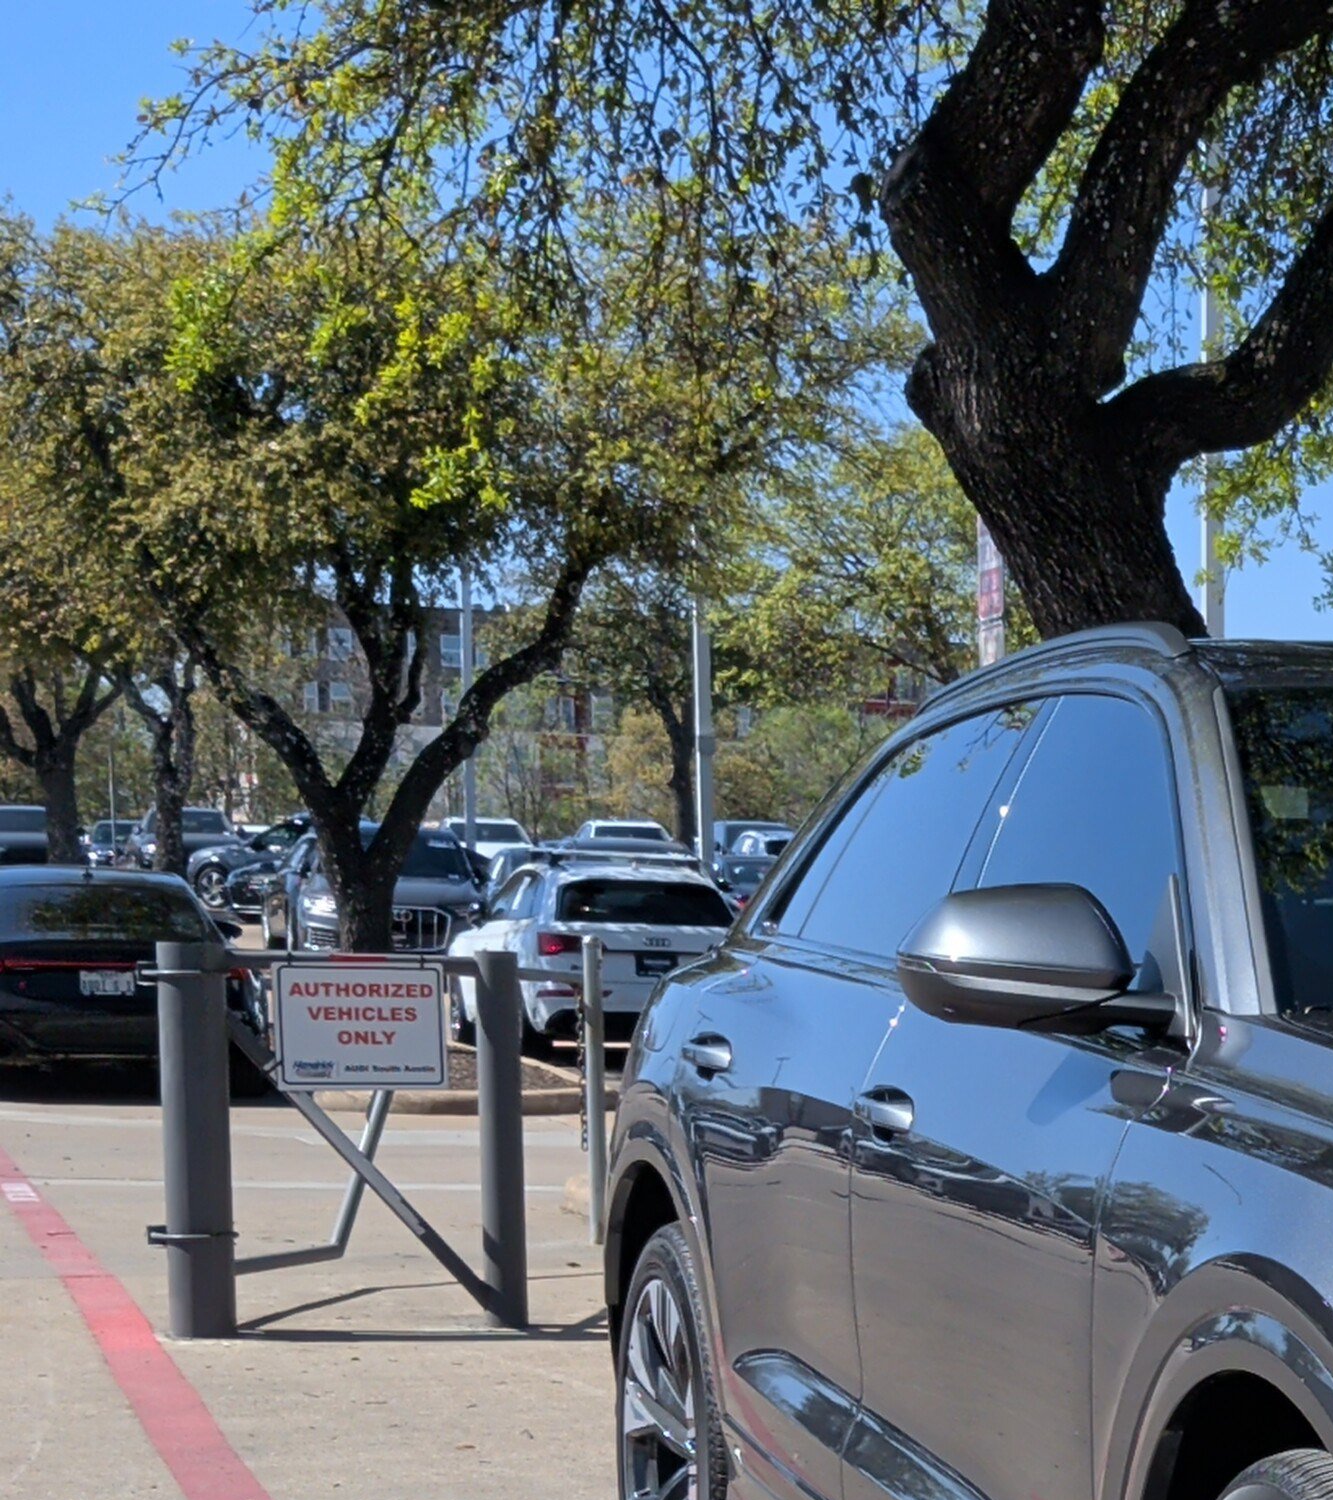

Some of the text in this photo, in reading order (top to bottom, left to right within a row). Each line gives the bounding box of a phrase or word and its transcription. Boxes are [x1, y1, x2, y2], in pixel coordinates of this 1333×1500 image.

[289, 982, 433, 998] AUTHORIZED
[307, 1006, 418, 1022] VEHICLES
[337, 1030, 396, 1045] ONLY
